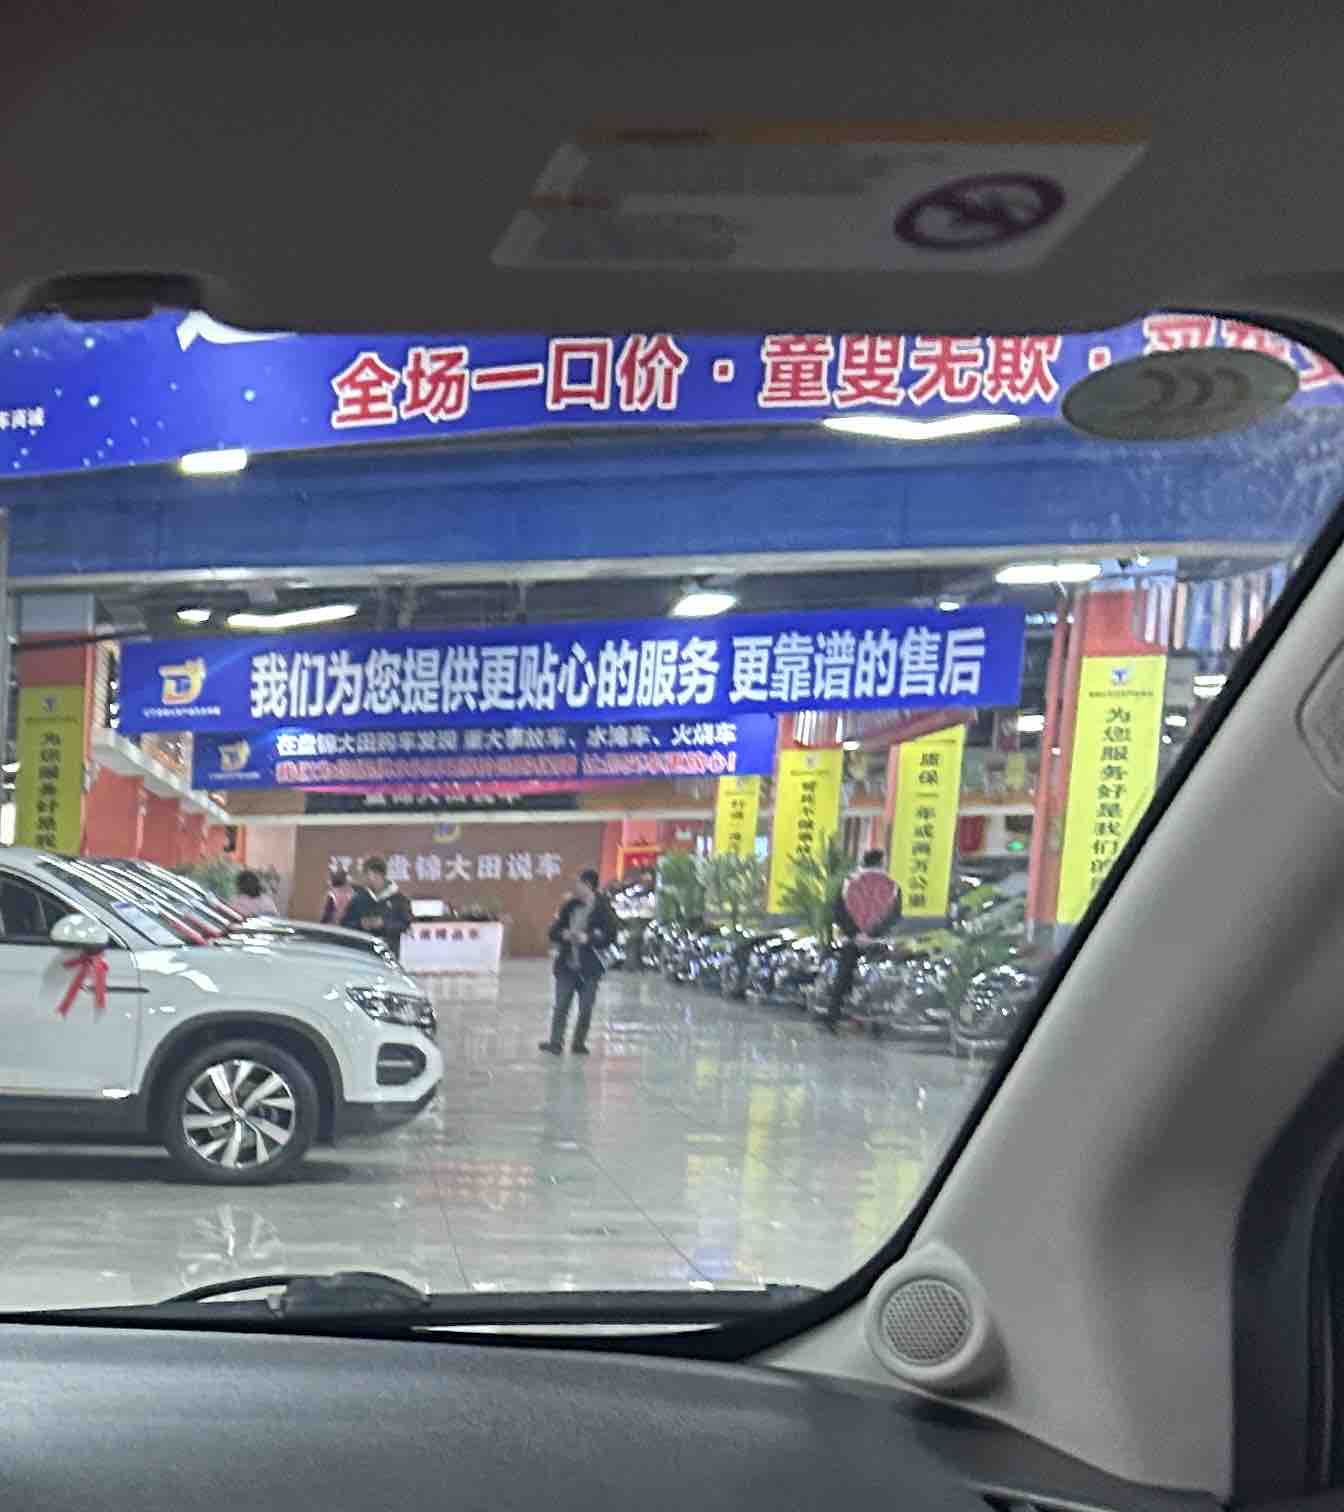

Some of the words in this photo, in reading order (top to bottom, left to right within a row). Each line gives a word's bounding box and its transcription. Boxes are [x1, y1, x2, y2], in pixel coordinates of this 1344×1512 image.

[250, 637, 720, 719] 我们为您提供更贴心的服务
[728, 626, 986, 703] 更靠谱的售后
